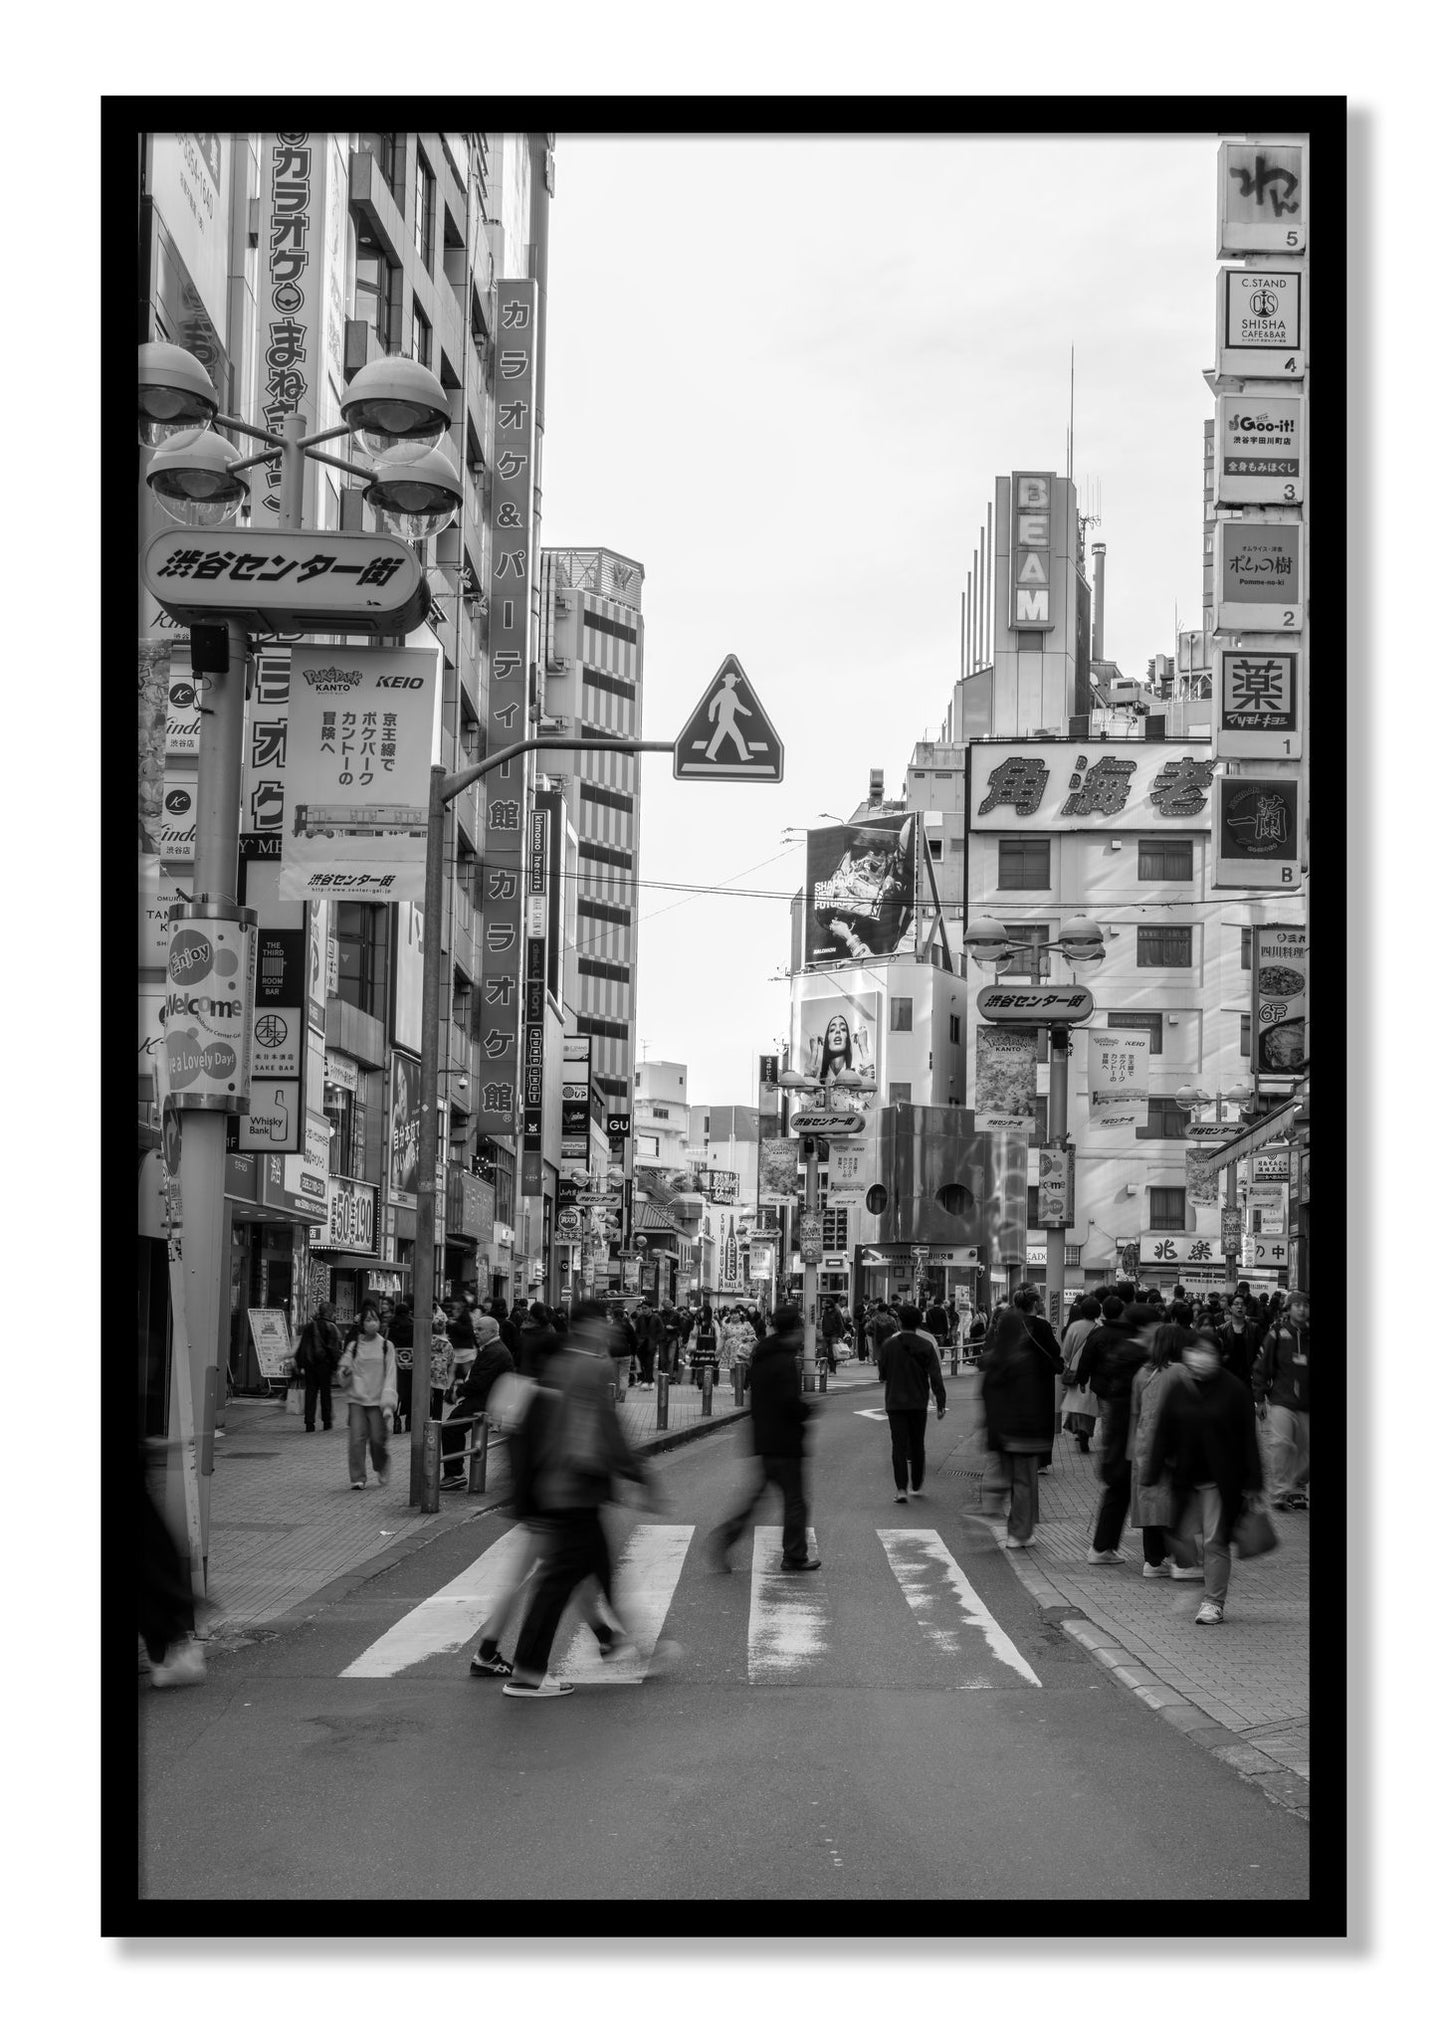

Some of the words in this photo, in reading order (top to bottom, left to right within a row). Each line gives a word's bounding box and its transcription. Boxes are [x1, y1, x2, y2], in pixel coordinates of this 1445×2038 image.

[270, 146, 312, 284] カラオケ
[1286, 231, 1298, 246] 5
[1242, 279, 1287, 288] C.STAND
[1242, 319, 1286, 329] SHISHA
[1242, 330, 1286, 338] CAFE&BAR
[1285, 357, 1297, 373] 4
[1234, 436, 1292, 446] 渋谷宇田川町店
[1228, 461, 1296, 473] 全身もみほぐし
[1283, 484, 1296, 500] 3
[1017, 476, 1049, 621] BEAM
[157, 548, 405, 587] 渋谷センター街
[1239, 578, 1285, 586] Pomme-no-ki
[1283, 611, 1295, 626] 2
[315, 684, 351, 692] KANTO
[376, 676, 424, 690] KEIO
[1232, 659, 1283, 711] 薬
[320, 711, 336, 754] 冒険へ
[171, 739, 194, 748] 渋谷店
[338, 711, 356, 786] カントーの
[380, 712, 397, 772] 京王線で
[1283, 739, 1291, 754] 1
[977, 755, 1217, 816] 角海老
[534, 815, 543, 850] kimono
[166, 846, 190, 855] 渋谷店
[307, 873, 396, 887] 渋谷センター街
[1281, 867, 1293, 882] B
[171, 943, 210, 977] Enjoy
[166, 993, 243, 1018] Welcome
[984, 994, 1087, 1008] 渋谷センター街
[1259, 1003, 1288, 1023] 6F
[183, 1050, 213, 1071] Lovely
[215, 1052, 235, 1067] Day!
[250, 1117, 283, 1128] Whisky
[609, 1120, 629, 1130] GU
[794, 1116, 856, 1127] 渋谷センター街
[249, 1126, 269, 1134] Bank
[1153, 1238, 1214, 1261] 兆楽
[726, 1237, 736, 1281] BEER
